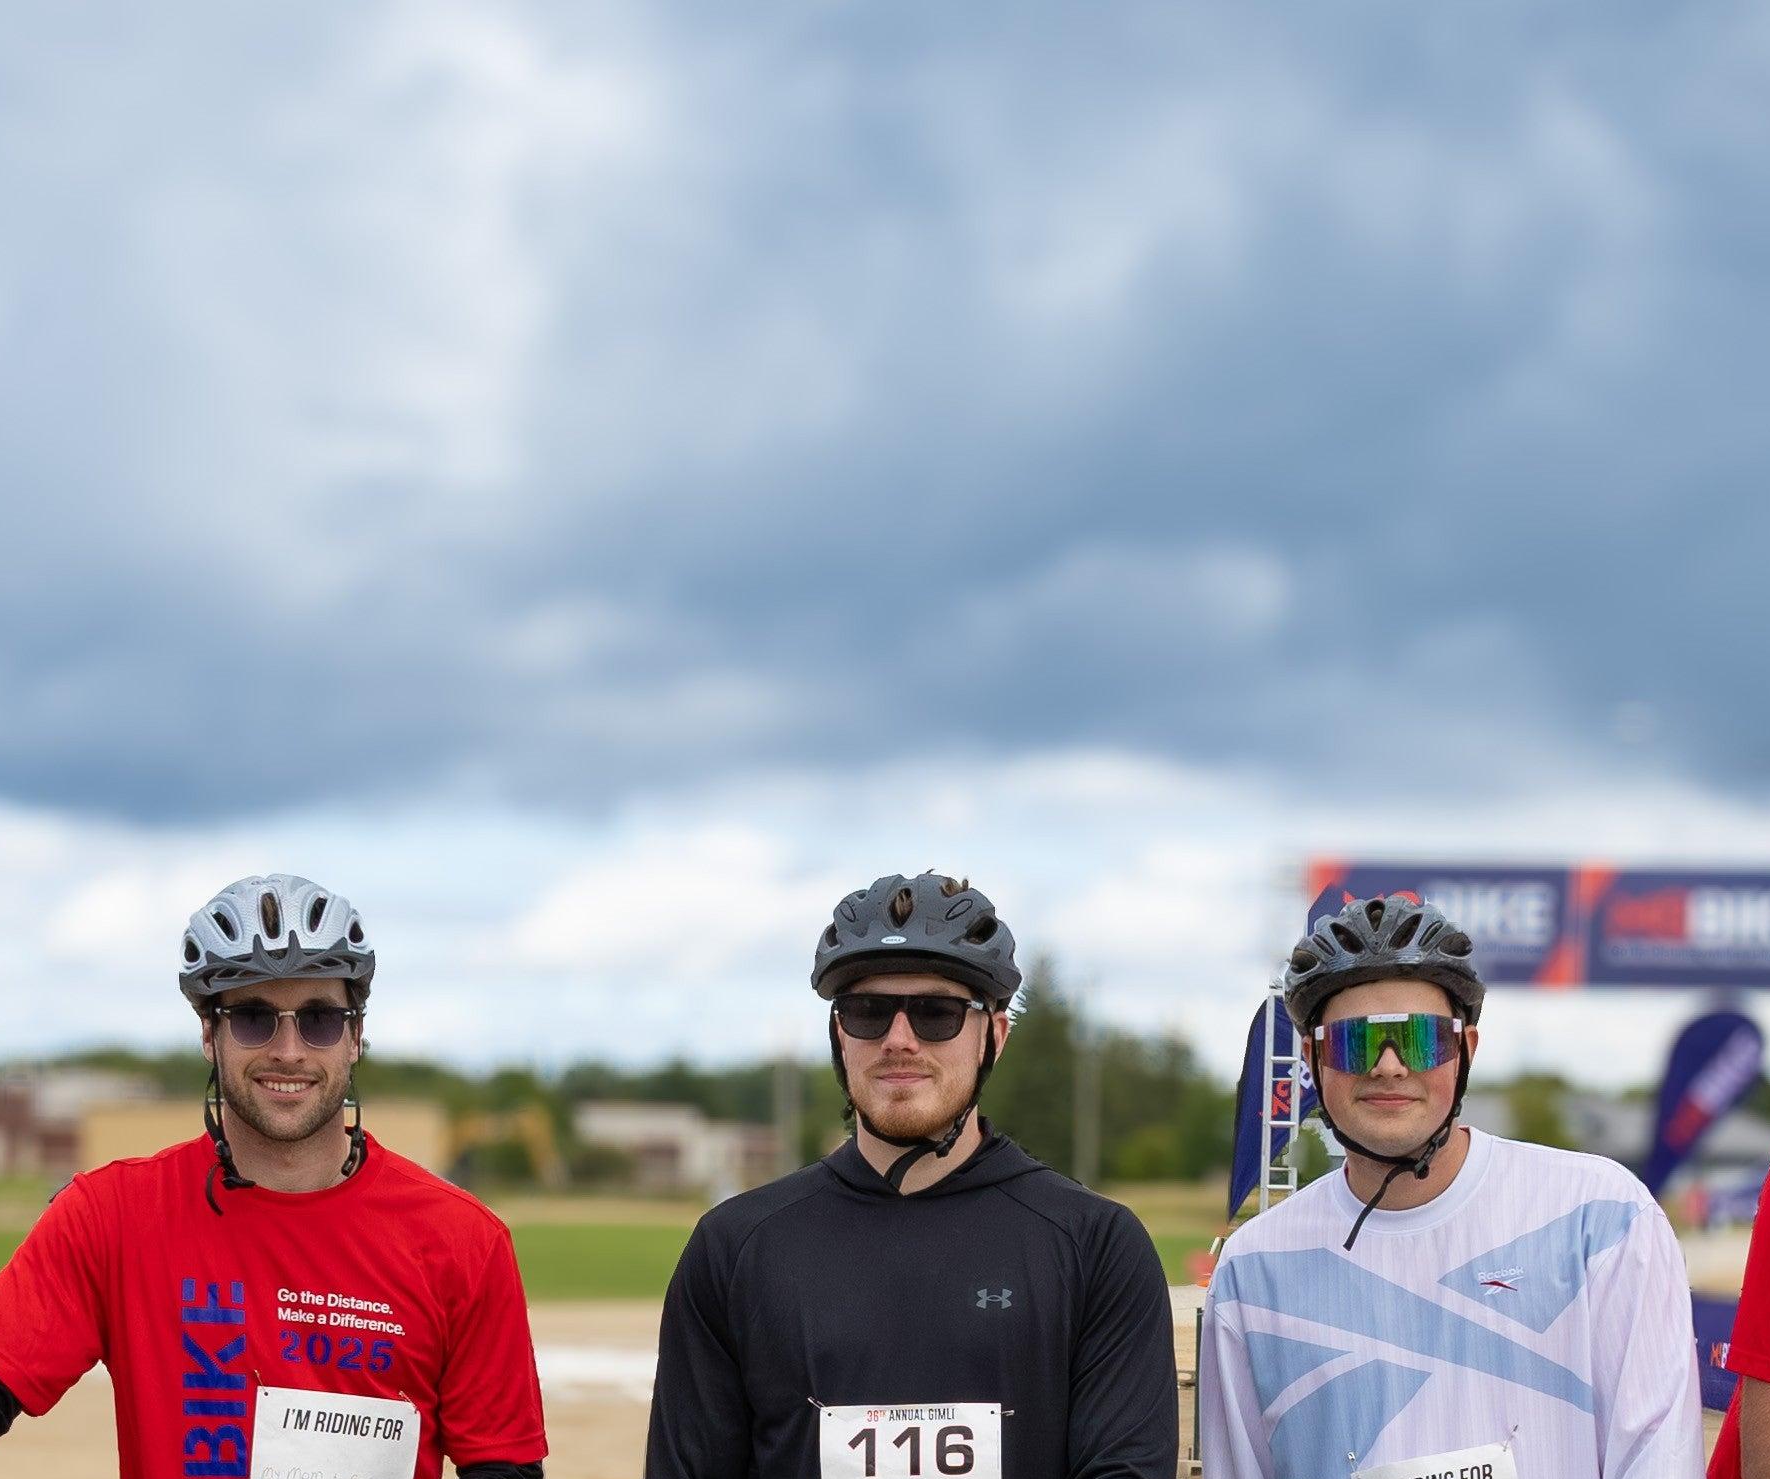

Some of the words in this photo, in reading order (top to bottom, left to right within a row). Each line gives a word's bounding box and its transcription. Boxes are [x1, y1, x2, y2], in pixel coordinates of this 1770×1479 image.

[1478, 1265, 1524, 1281] Reebok
[277, 1288, 298, 1303] Go
[300, 1290, 325, 1306] the
[326, 1293, 394, 1315] Distance.
[277, 1307, 315, 1323] Make
[316, 1313, 327, 1324] a
[329, 1312, 406, 1336] Difference.
[279, 1331, 396, 1372] 2025
[283, 1408, 310, 1429] I'M
[313, 1411, 371, 1438] RIDING
[373, 1417, 404, 1441] FOR
[866, 1410, 886, 1423] 36TH
[888, 1408, 925, 1422] ANNUAL
[928, 1408, 955, 1421] GIMLI
[847, 1425, 975, 1477] 116
